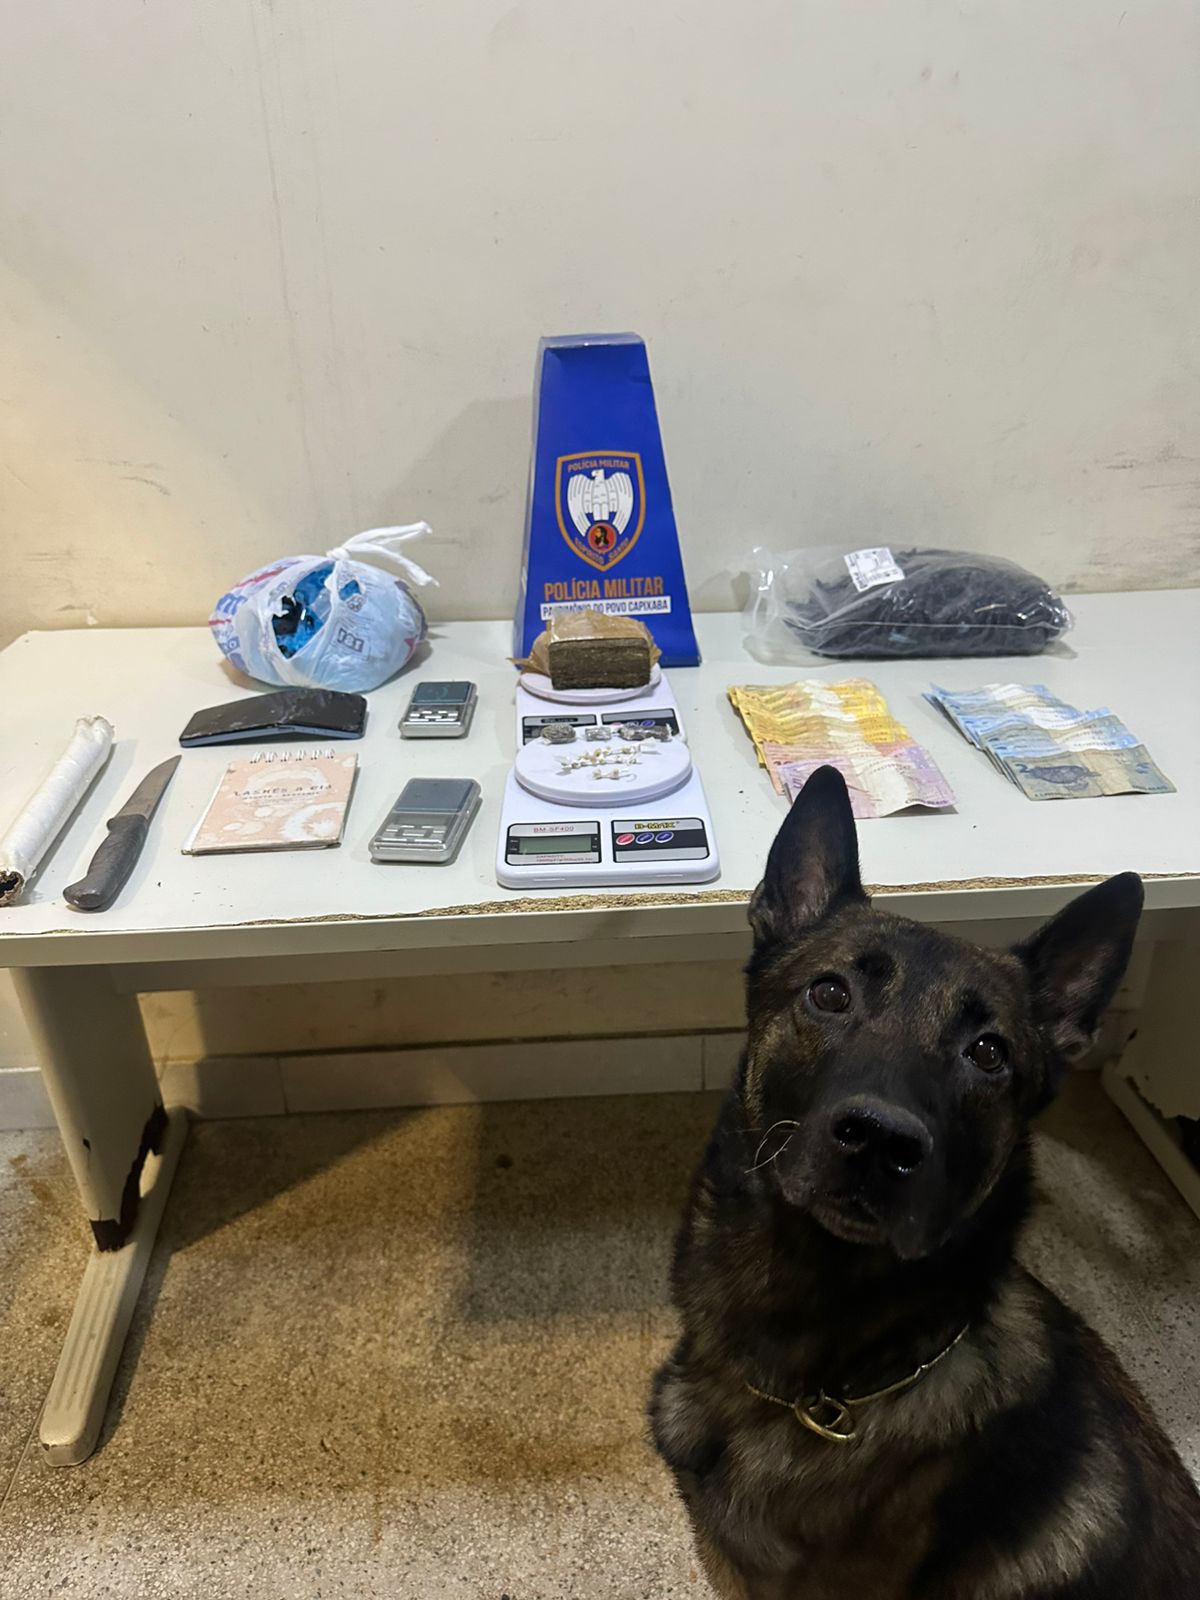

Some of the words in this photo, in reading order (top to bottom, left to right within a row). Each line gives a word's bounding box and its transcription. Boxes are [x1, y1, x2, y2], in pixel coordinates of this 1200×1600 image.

[568, 460, 597, 472] POLÍCIA
[600, 460, 630, 470] MILITAR
[544, 578, 600, 601] POLÍCIA
[604, 576, 664, 598] MILITAR
[605, 601, 627, 613] POVO
[628, 599, 669, 612] CAPIXABA
